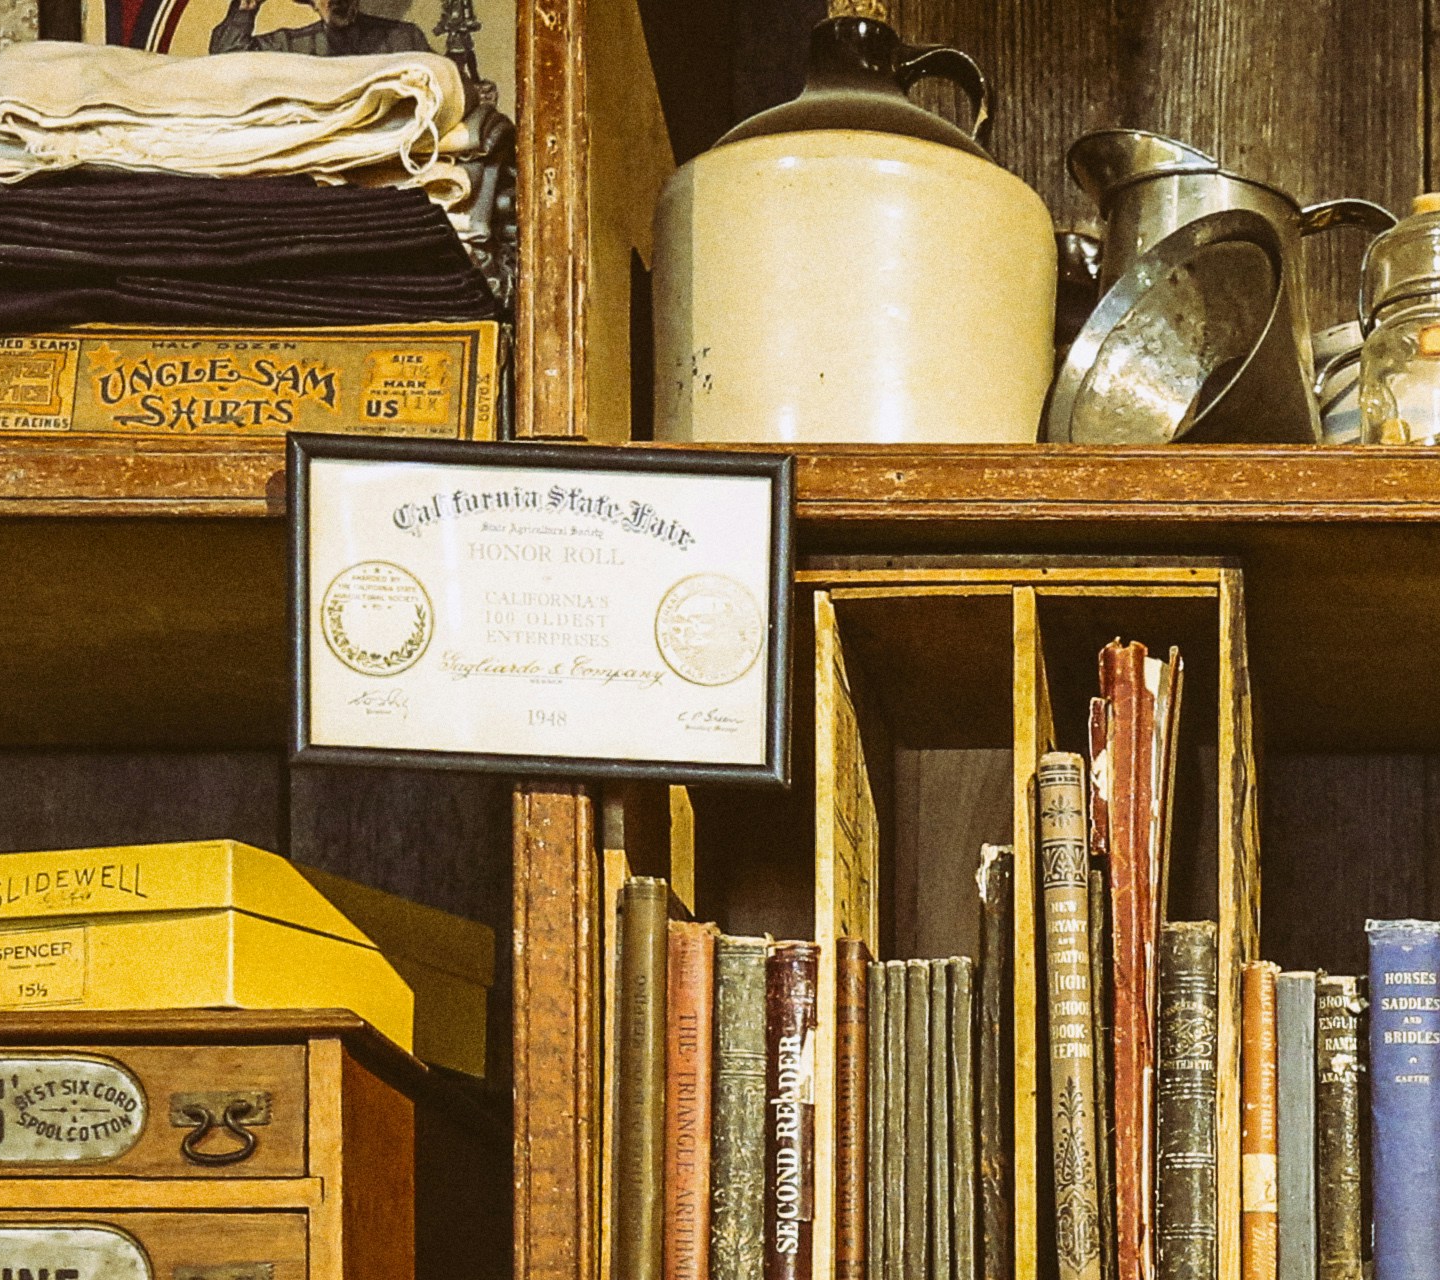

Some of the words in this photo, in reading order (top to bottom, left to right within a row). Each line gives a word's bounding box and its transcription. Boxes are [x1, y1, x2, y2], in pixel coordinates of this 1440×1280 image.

[253, 359, 335, 407] SAM
[383, 380, 426, 388] MARK
[114, 397, 293, 432] SHIRTS
[366, 400, 399, 417] US
[14, 416, 69, 430] FACINGS
[393, 487, 539, 536] California
[469, 542, 555, 563] HONOR
[563, 545, 625, 566] ROLL
[486, 629, 610, 647] ENTERPRISES
[527, 709, 568, 727] 1948
[1384, 972, 1437, 986] HORSES
[1381, 996, 1440, 1012] SADDLES
[1384, 1029, 1440, 1045] BRIDLES
[776, 1034, 801, 1151] READER
[776, 1158, 801, 1256] SECOND
